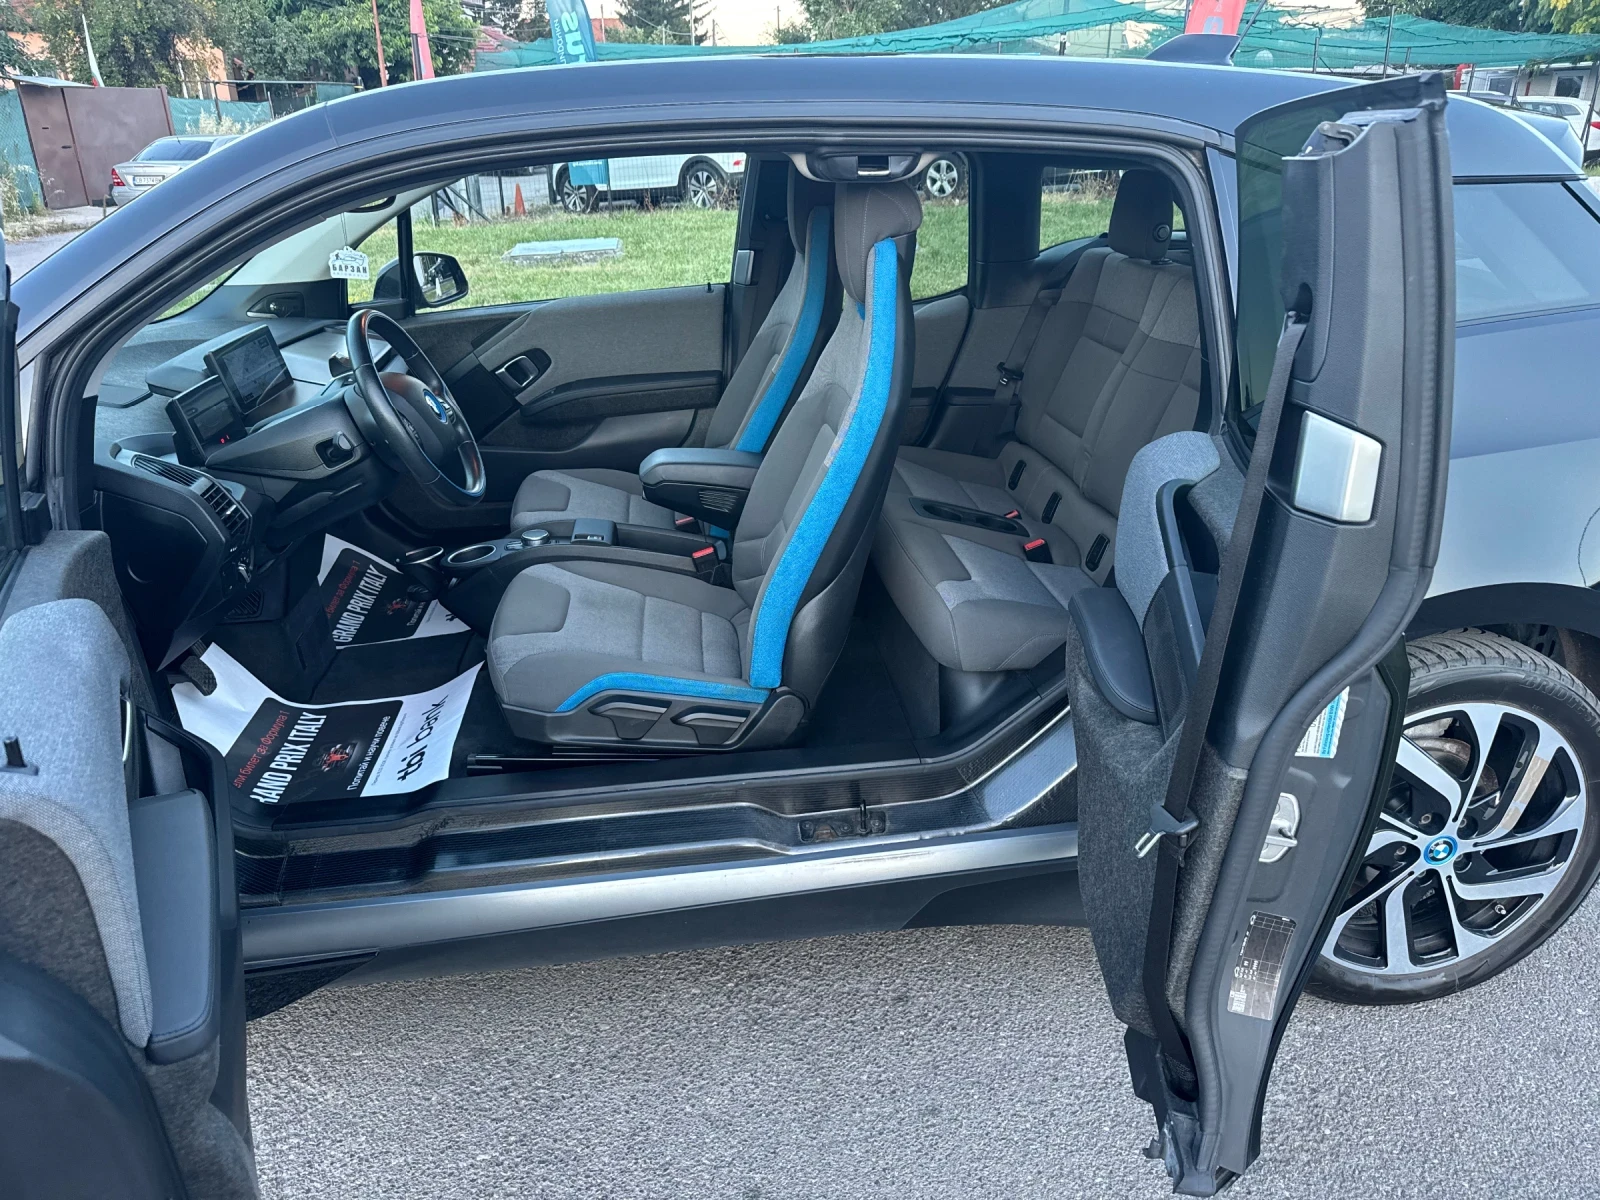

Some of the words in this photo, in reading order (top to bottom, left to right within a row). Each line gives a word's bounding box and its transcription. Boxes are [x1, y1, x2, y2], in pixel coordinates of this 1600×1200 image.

[332, 264, 367, 273] БАРЗАН
[358, 564, 388, 595] ITALY
[347, 589, 377, 614] PRIX
[332, 612, 365, 643] GRAND
[260, 714, 288, 745] Формула
[287, 711, 327, 741] ITALY
[406, 694, 449, 749] bank
[240, 753, 262, 775] билет
[257, 744, 268, 755] за
[269, 742, 311, 771] PRIX
[346, 761, 370, 791] Попитай
[366, 737, 382, 757] научи
[375, 715, 391, 737] повече
[397, 744, 428, 781] tbi
